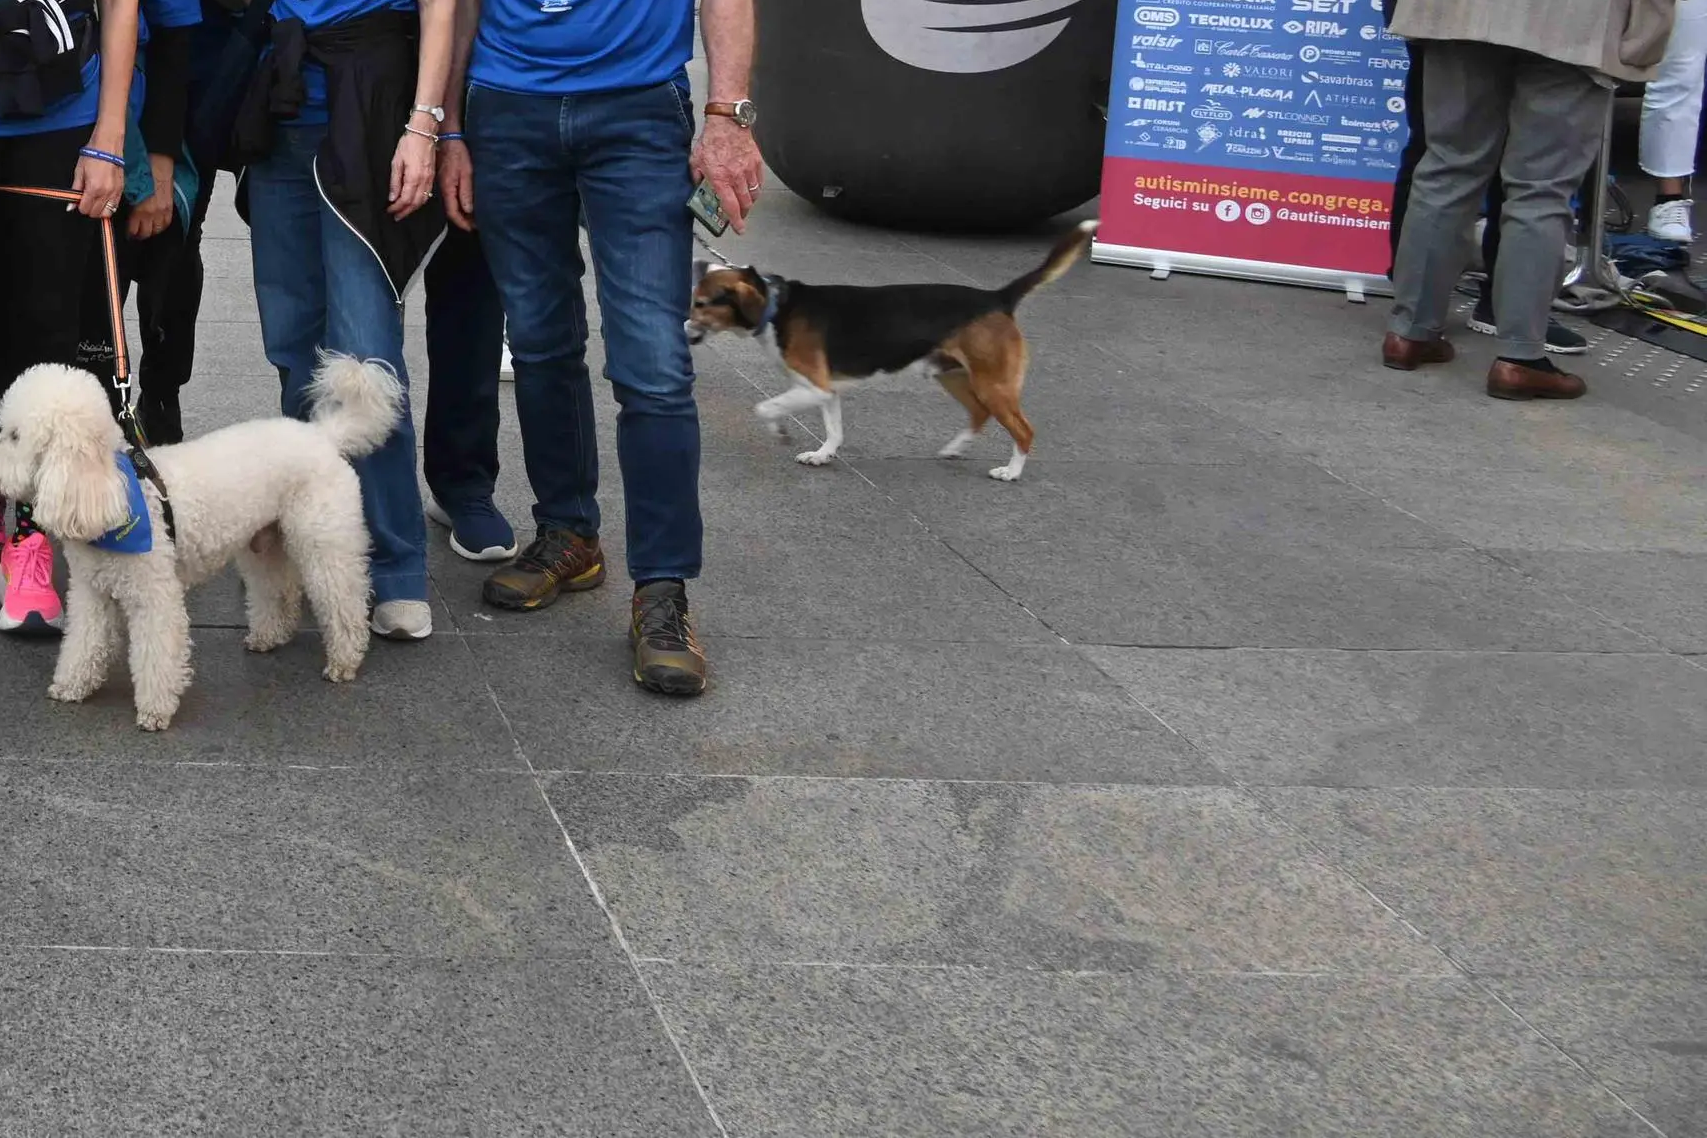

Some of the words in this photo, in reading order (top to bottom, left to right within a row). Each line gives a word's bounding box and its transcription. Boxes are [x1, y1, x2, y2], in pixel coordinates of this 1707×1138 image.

[1192, 1, 1242, 9] COOPERATIVO
[1138, 10, 1175, 23] OMS
[1188, 13, 1275, 30] TECNOLUX
[1305, 20, 1340, 35] RIPA
[1132, 33, 1184, 48] valsir
[1319, 74, 1374, 87] savarbrass
[1325, 93, 1376, 105] ATHENA
[1134, 175, 1390, 214] autisminsieme.congrega.
[1133, 193, 1187, 212] Seguici
[1192, 201, 1210, 212] su
[1276, 208, 1391, 231] @autisminsiem
